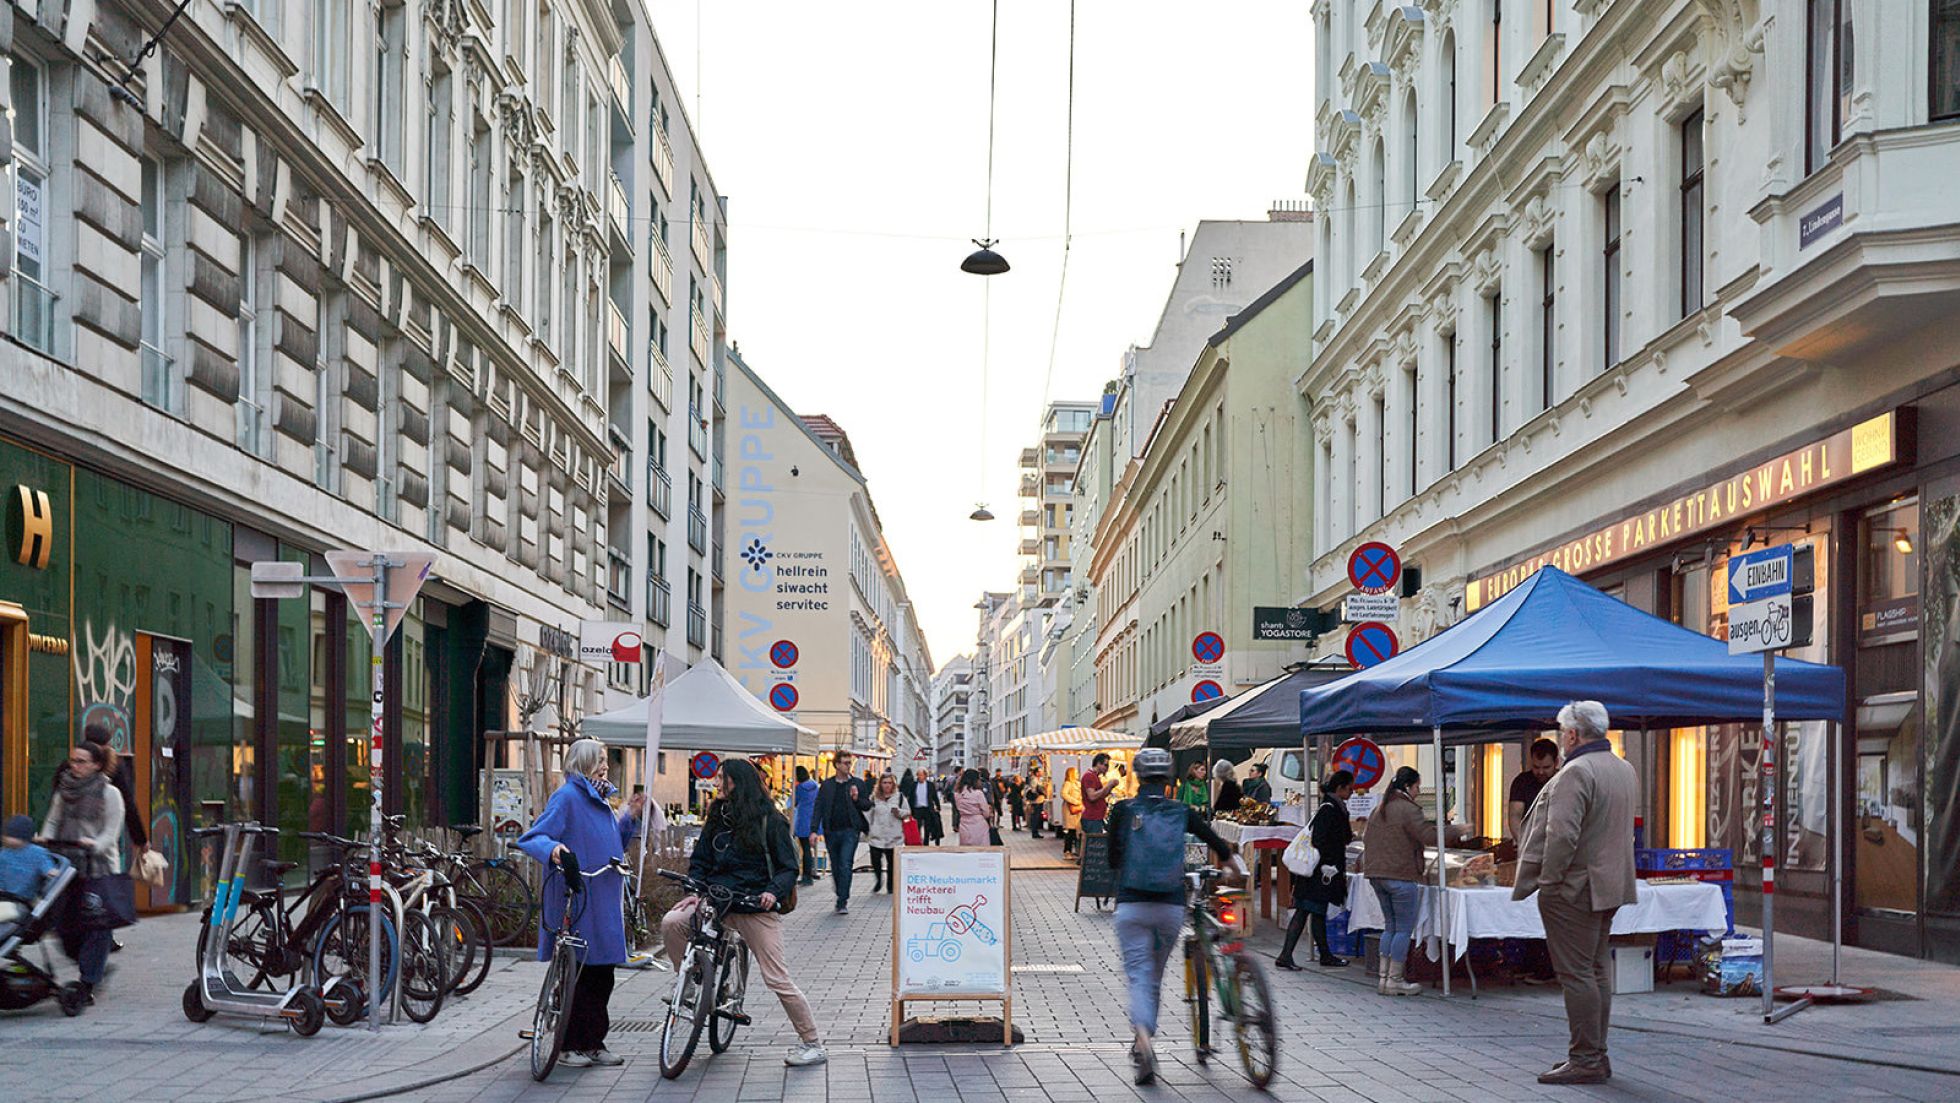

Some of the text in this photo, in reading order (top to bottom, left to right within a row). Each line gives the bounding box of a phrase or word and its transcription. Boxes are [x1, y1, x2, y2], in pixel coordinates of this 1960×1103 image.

[738, 403, 775, 593] GRUPPE
[1623, 445, 1831, 552] PARKETTAUSWAHL
[776, 565, 828, 577] hellrein
[1747, 559, 1785, 587] EINBAHN
[776, 582, 828, 593] siwacht
[776, 599, 828, 610] servitec
[1260, 629, 1312, 638] YOGASTORE
[1730, 619, 1761, 642] ausgen.
[1740, 724, 1762, 863] PARKE
[907, 875, 997, 884] DER Neubaumarkt
[906, 886, 956, 894] Markterei
[907, 895, 932, 904] trifft
[906, 906, 945, 914] Neubau
